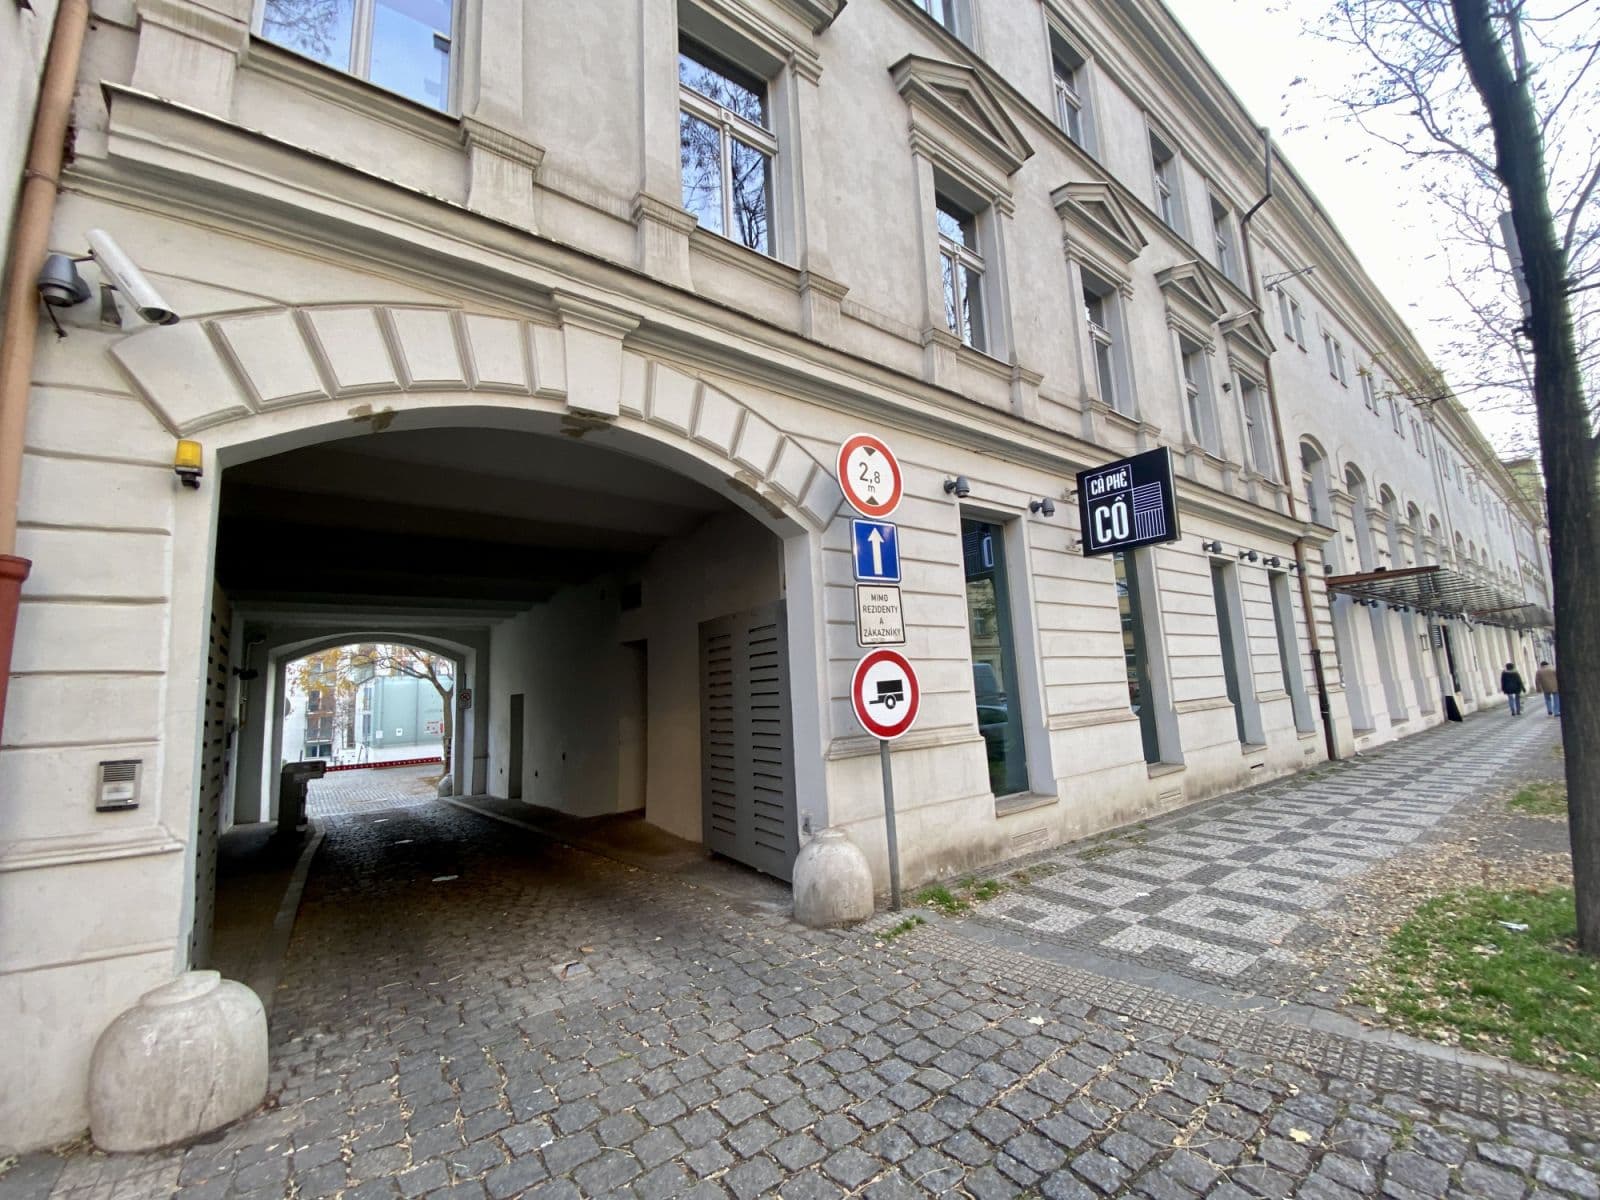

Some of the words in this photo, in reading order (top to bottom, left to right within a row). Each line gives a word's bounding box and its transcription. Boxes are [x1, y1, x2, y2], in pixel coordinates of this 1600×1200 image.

[859, 461, 880, 484] 2,8
[868, 485, 876, 493] m
[862, 605, 898, 614] REZIDENTY
[879, 616, 884, 625] A
